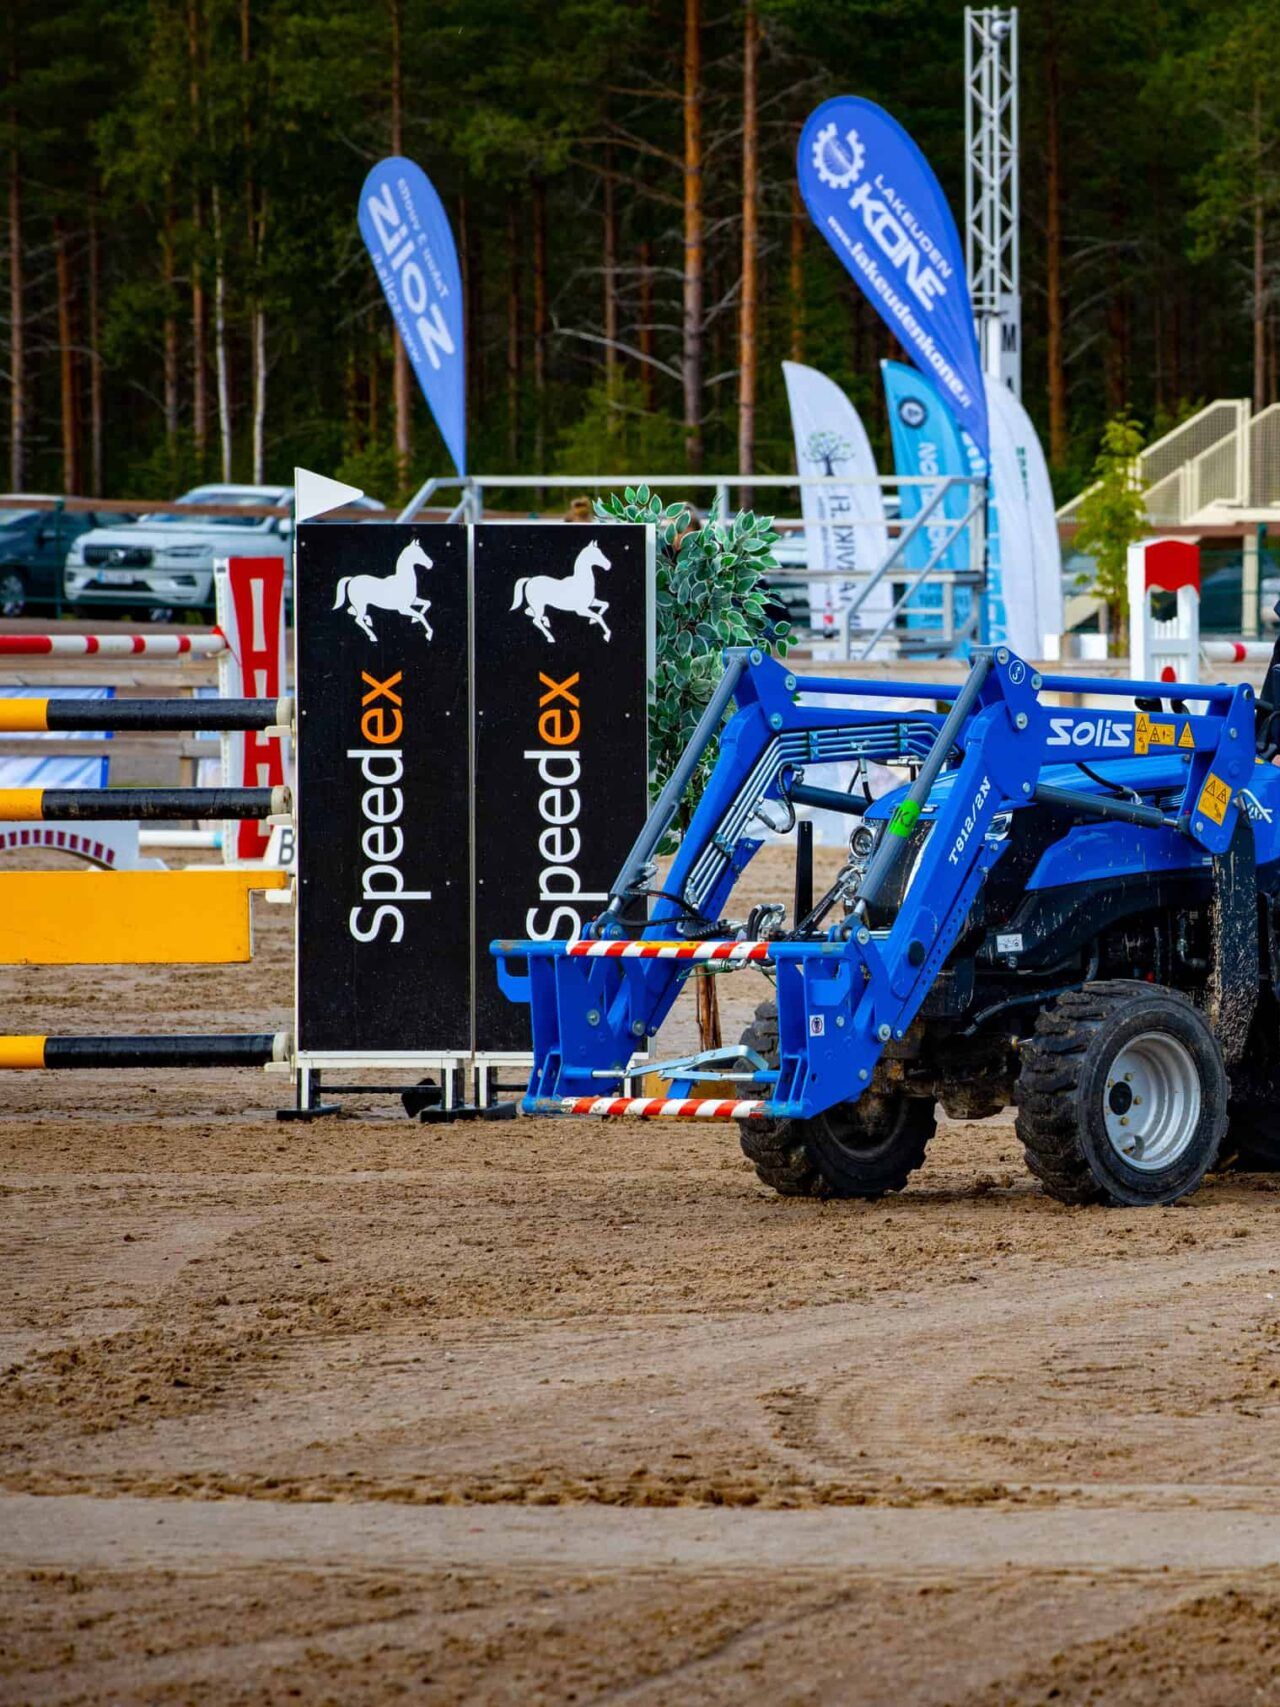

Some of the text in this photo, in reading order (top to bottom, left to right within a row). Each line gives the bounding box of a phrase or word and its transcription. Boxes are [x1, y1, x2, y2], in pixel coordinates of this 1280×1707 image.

[849, 181, 947, 313] KONE
[874, 173, 952, 279] LAKEUDEN
[827, 215, 971, 410] www.lakeudenkone.fi
[278, 829, 295, 865] B
[347, 670, 433, 943] Speedex
[523, 670, 611, 942] Speedex
[949, 775, 991, 866] T812/2N
